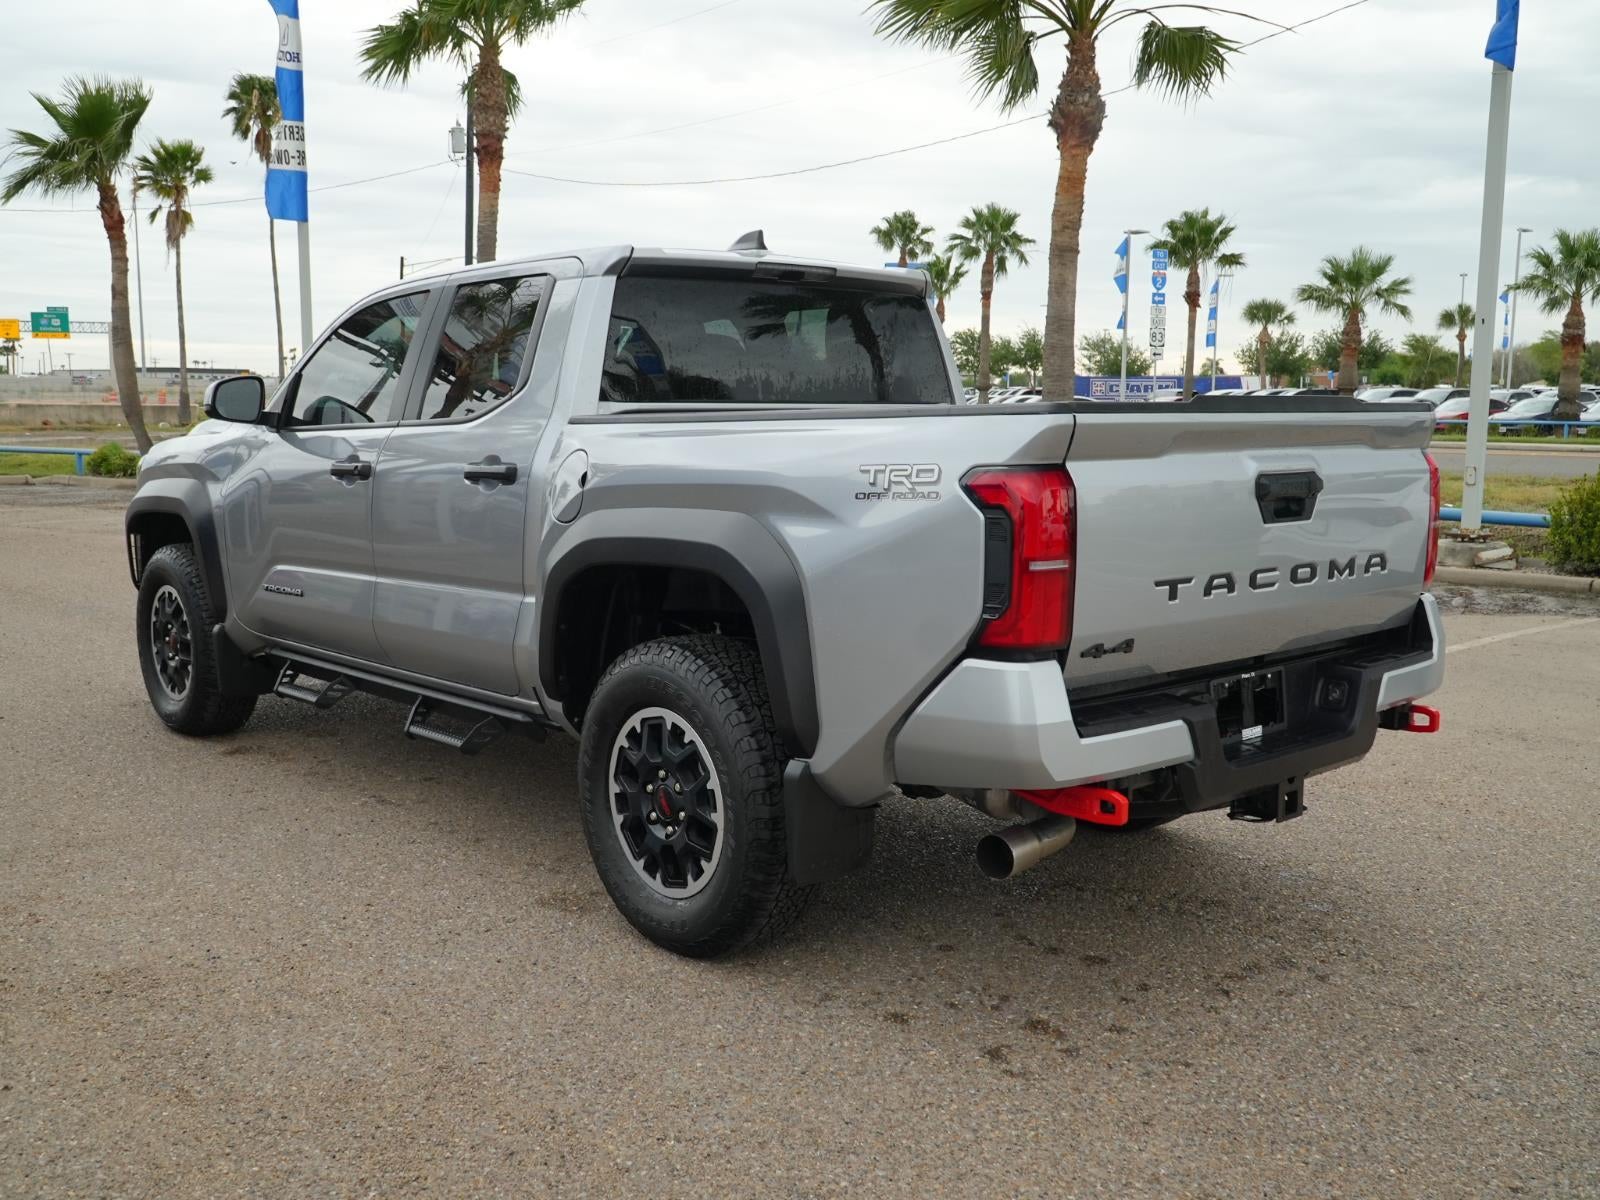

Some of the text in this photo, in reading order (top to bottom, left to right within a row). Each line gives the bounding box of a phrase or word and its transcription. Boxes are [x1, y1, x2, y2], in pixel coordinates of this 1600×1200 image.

[1156, 278, 1162, 288] 2
[1152, 332, 1163, 342] 83
[859, 464, 942, 491] TRD
[855, 491, 941, 500] OFF ROAD
[1153, 552, 1388, 603] TACOMA
[262, 584, 304, 597] TACOMA
